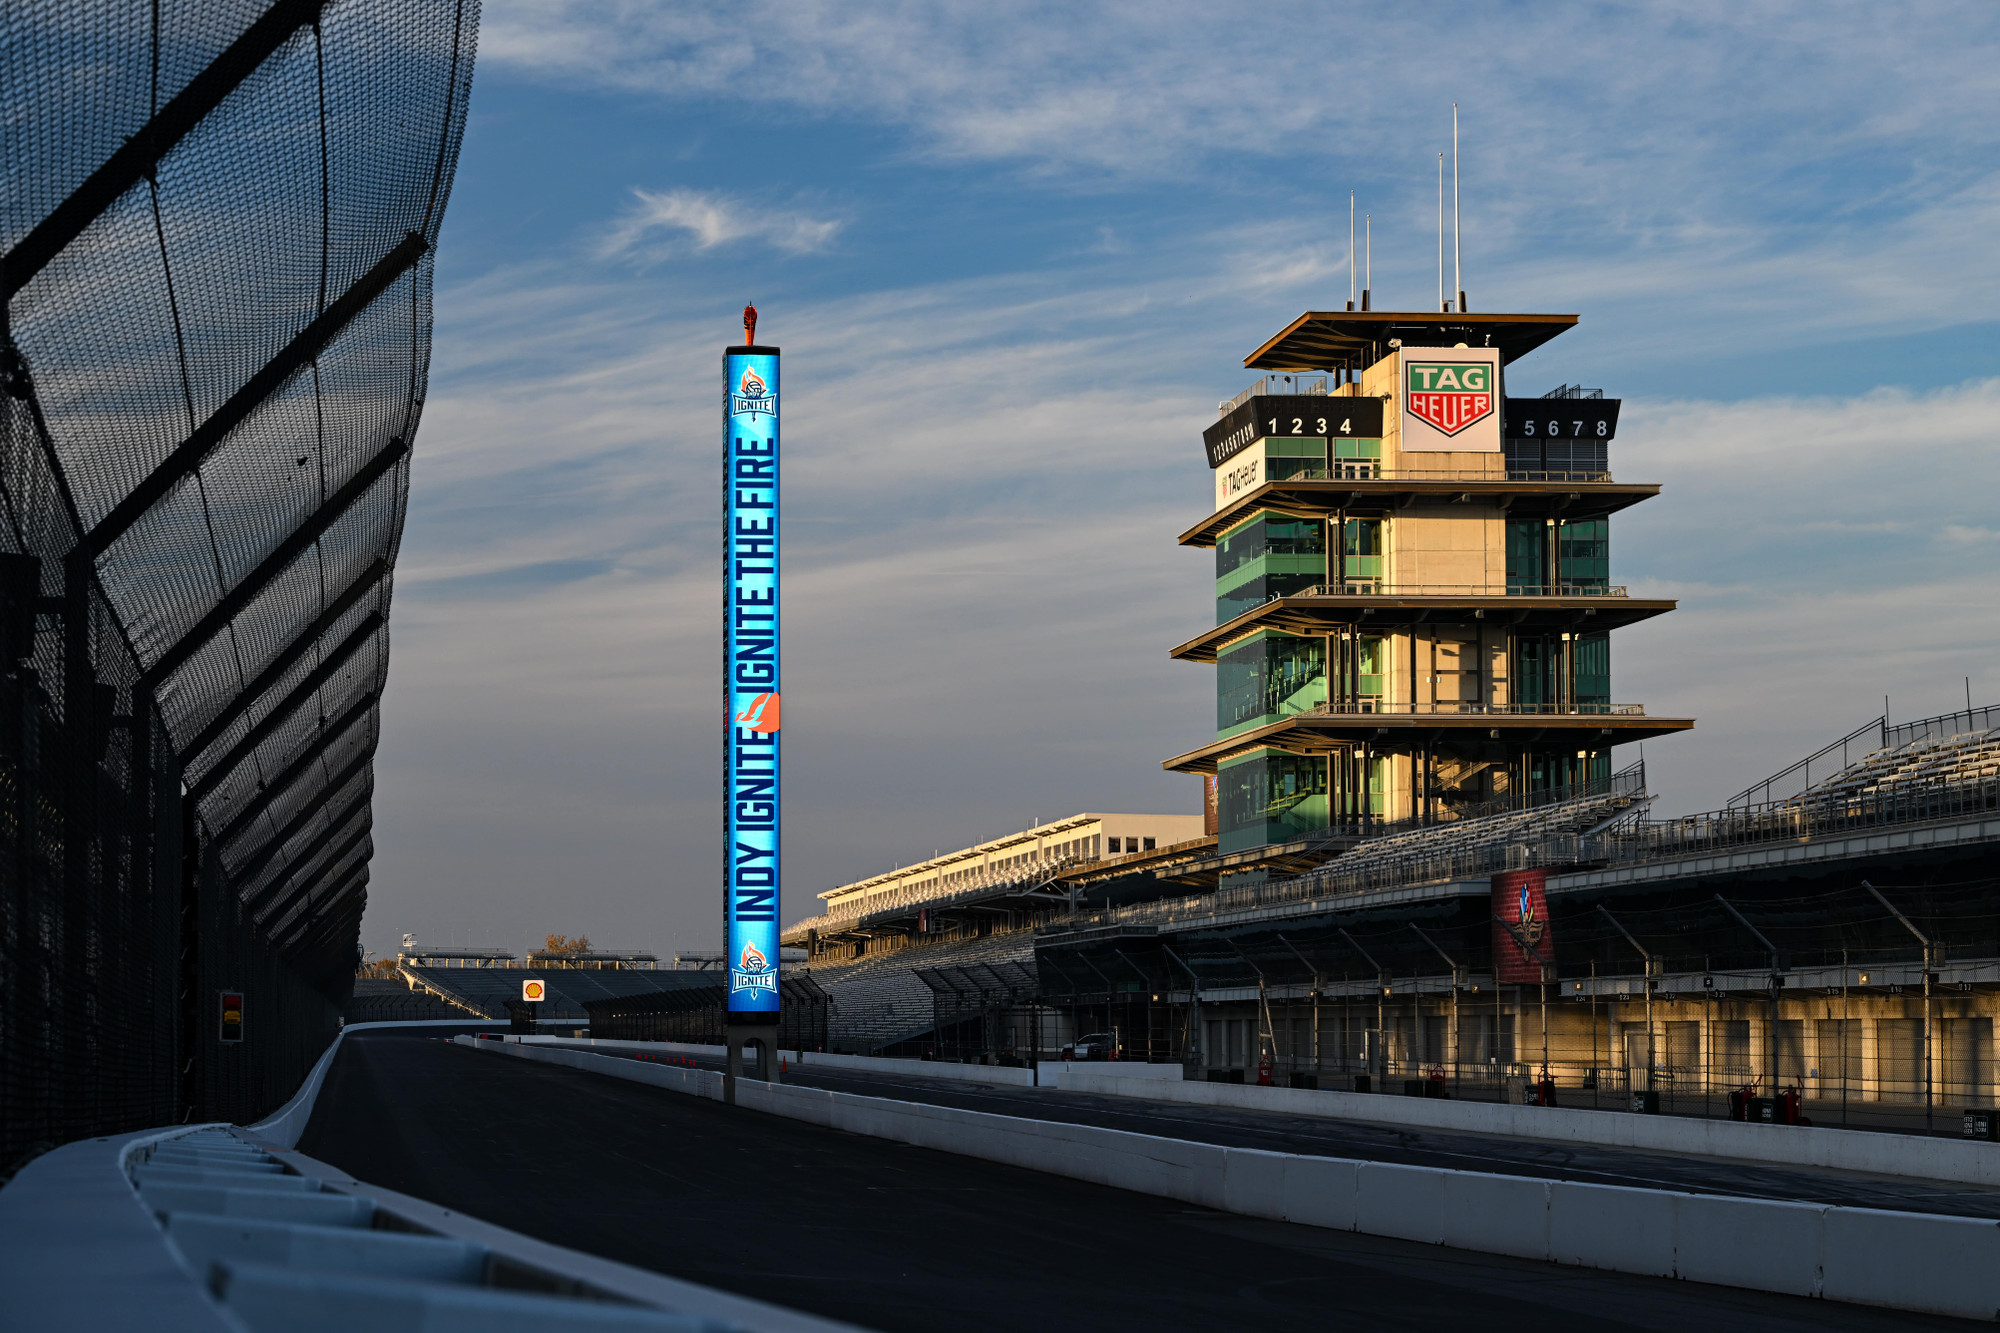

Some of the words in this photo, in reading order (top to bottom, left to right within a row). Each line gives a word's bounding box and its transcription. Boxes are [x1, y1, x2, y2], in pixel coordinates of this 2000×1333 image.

[1415, 368, 1484, 390] TAG
[738, 400, 770, 411] IGNITE
[1413, 396, 1486, 429] HEUER
[1268, 418, 1277, 434] 1
[1291, 418, 1303, 434] 2
[1316, 418, 1328, 434] 3
[1340, 418, 1352, 434] 4
[1524, 420, 1535, 436] 5
[1548, 420, 1559, 436] 6
[1572, 420, 1584, 436] 7
[1596, 420, 1607, 436] 8
[736, 437, 774, 509] FIRE
[736, 516, 774, 581] THE
[736, 586, 774, 694] IGNITE
[736, 726, 774, 832] IGNITE
[736, 841, 774, 922] INDY
[738, 975, 771, 986] IGNITE
